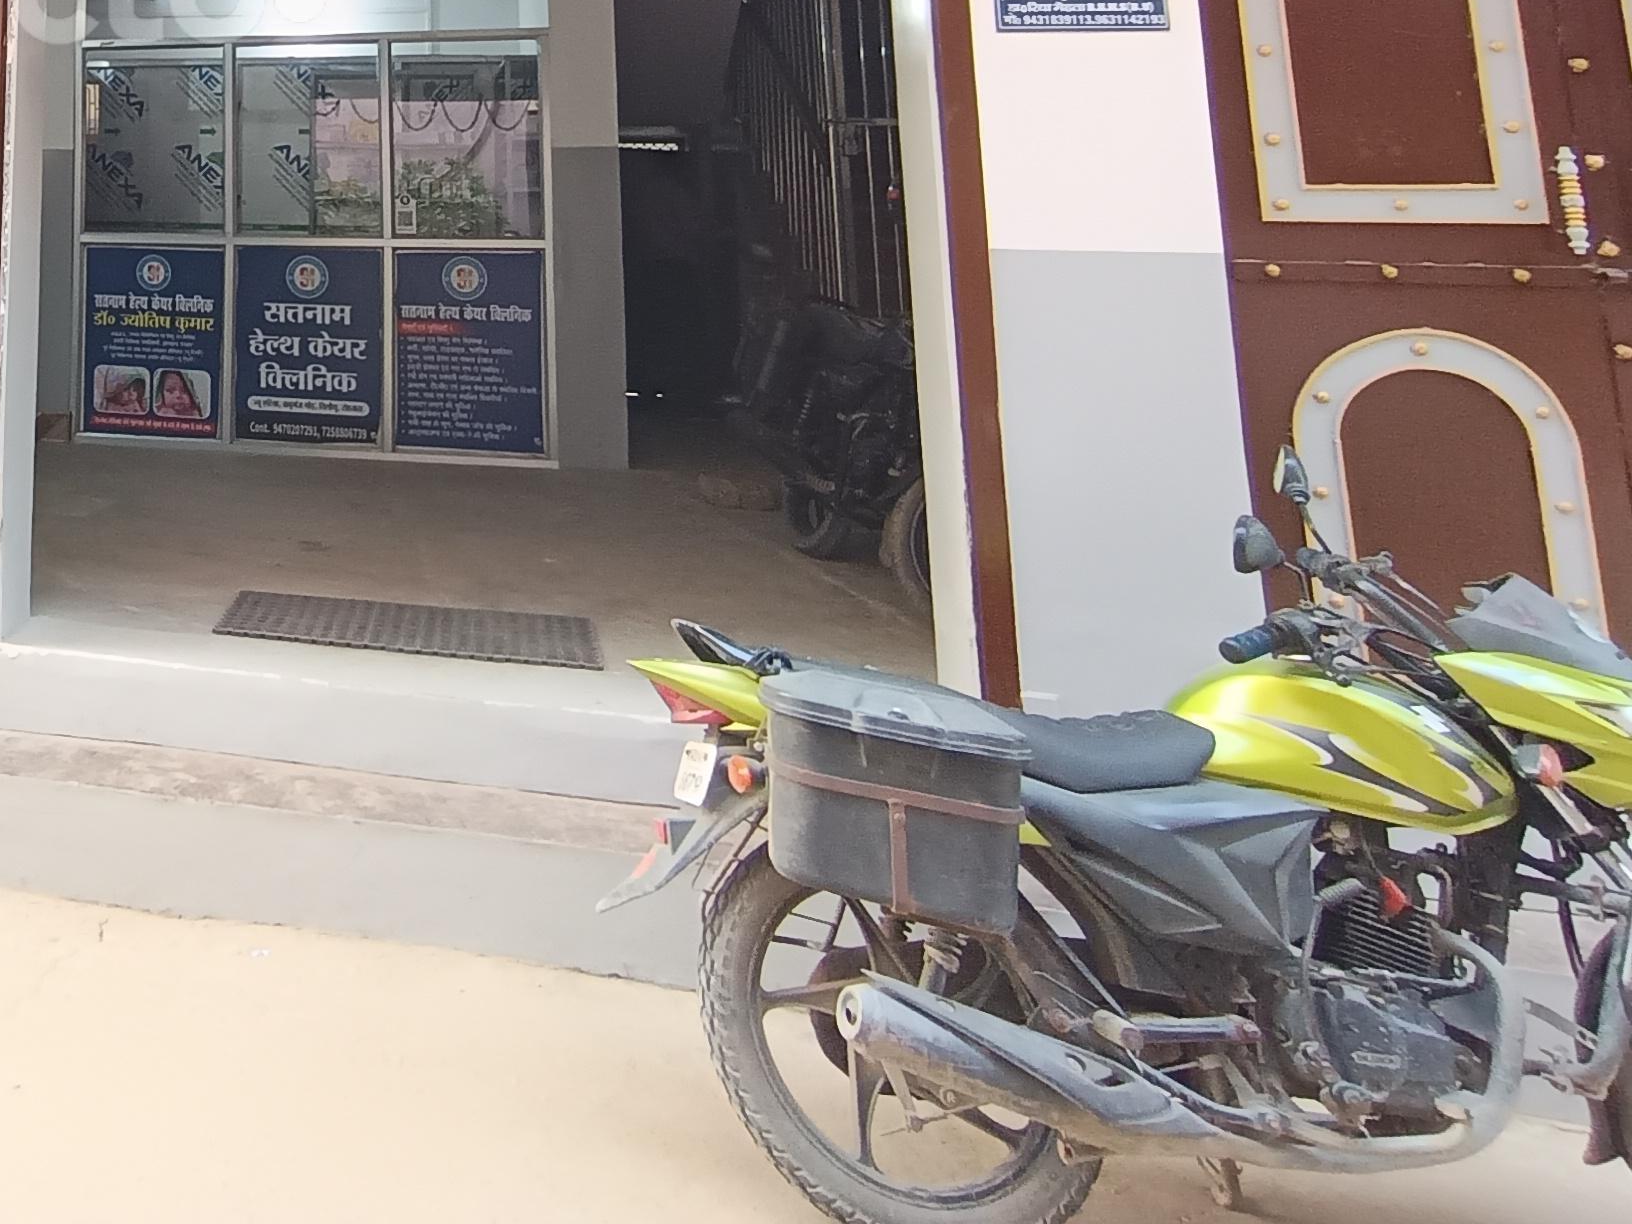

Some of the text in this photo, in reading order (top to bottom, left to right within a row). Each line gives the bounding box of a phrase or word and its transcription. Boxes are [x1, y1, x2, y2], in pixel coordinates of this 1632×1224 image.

[93, 310, 214, 334] डॉ० ज्योतिष कुमार
[264, 302, 352, 325] सत्तनाम
[248, 328, 367, 360] हेल्थ केयर
[259, 361, 357, 392] क्लिनिक
